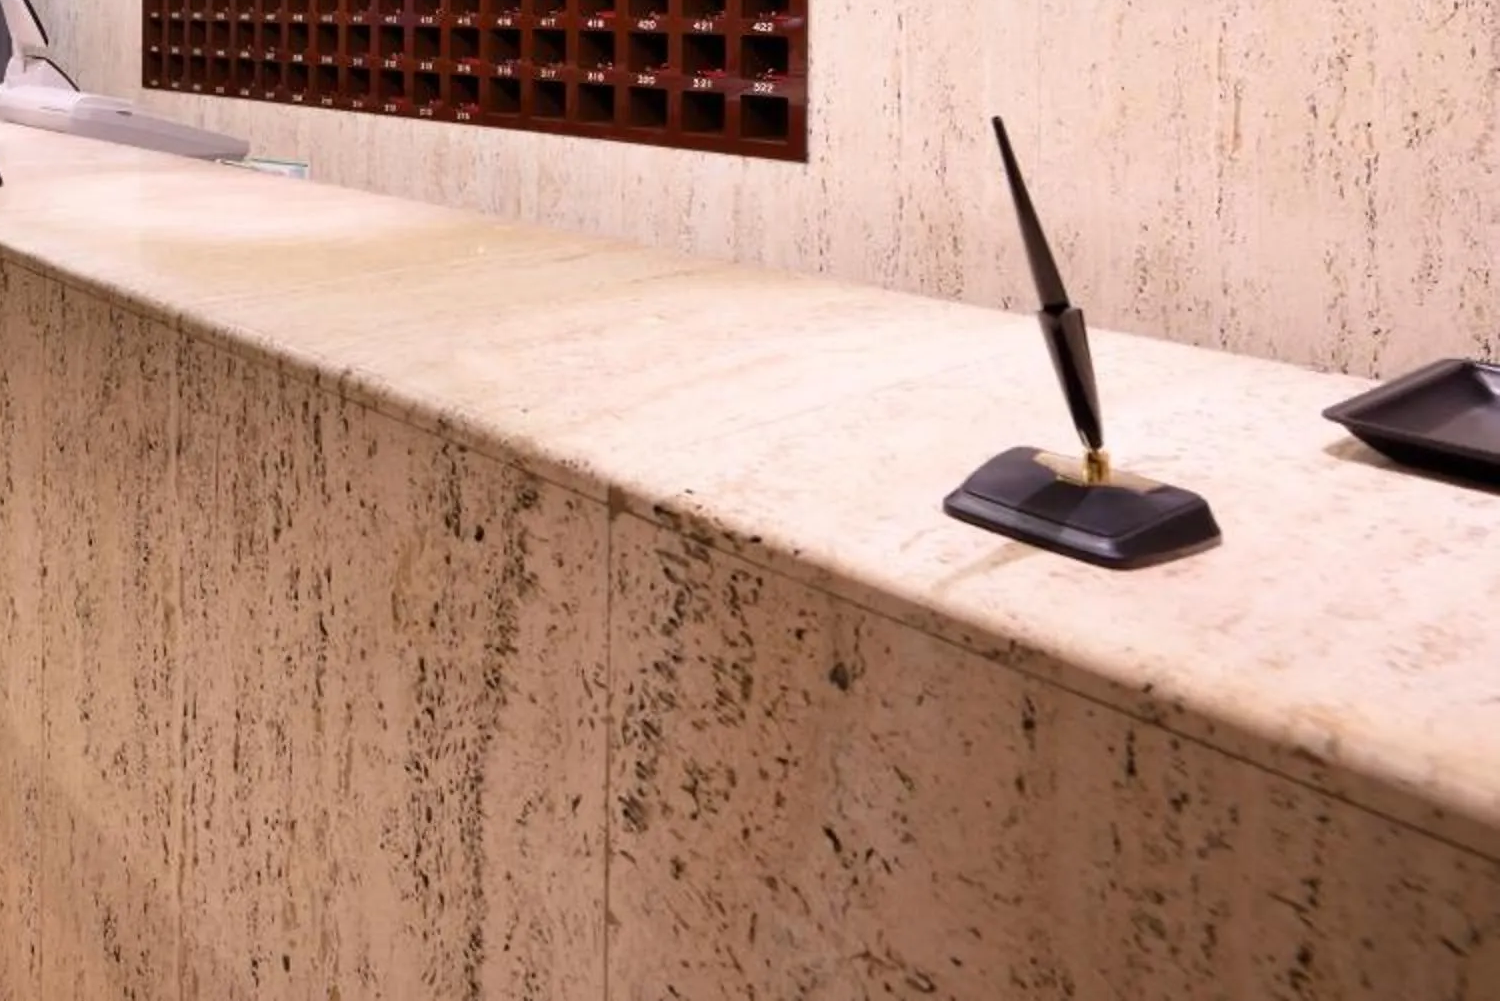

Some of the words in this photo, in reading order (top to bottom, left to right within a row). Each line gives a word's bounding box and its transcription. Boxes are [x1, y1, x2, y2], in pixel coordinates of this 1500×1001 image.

[637, 19, 657, 29] 420
[693, 21, 713, 31] 421
[752, 22, 774, 32] 422
[692, 78, 713, 88] 321
